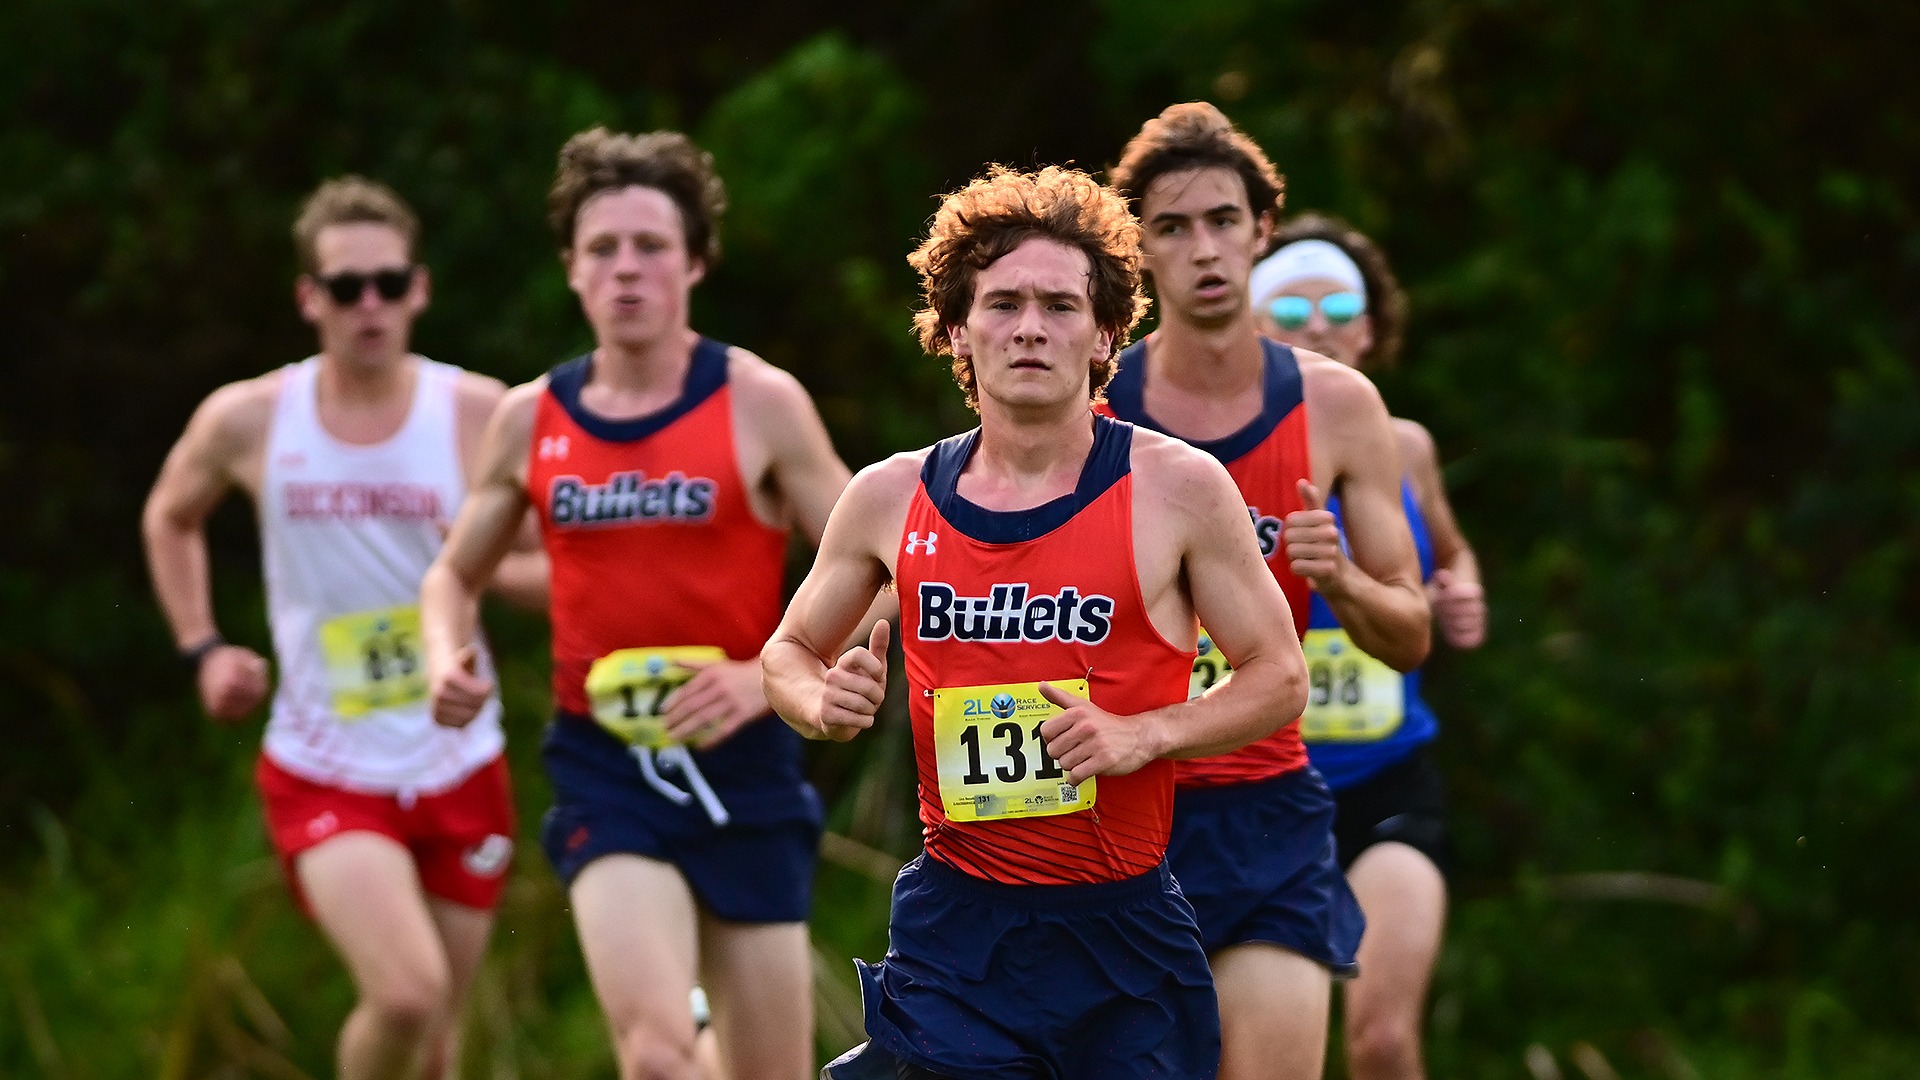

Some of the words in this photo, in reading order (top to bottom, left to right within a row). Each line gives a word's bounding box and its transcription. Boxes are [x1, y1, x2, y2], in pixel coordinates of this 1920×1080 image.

[549, 470, 718, 527] Bullets
[918, 581, 1115, 646] Bullets
[620, 676, 690, 719] 12
[963, 699, 991, 716] 2L
[1016, 703, 1051, 711] SERVICES
[960, 720, 1064, 786] 131
[978, 795, 990, 803] 131
